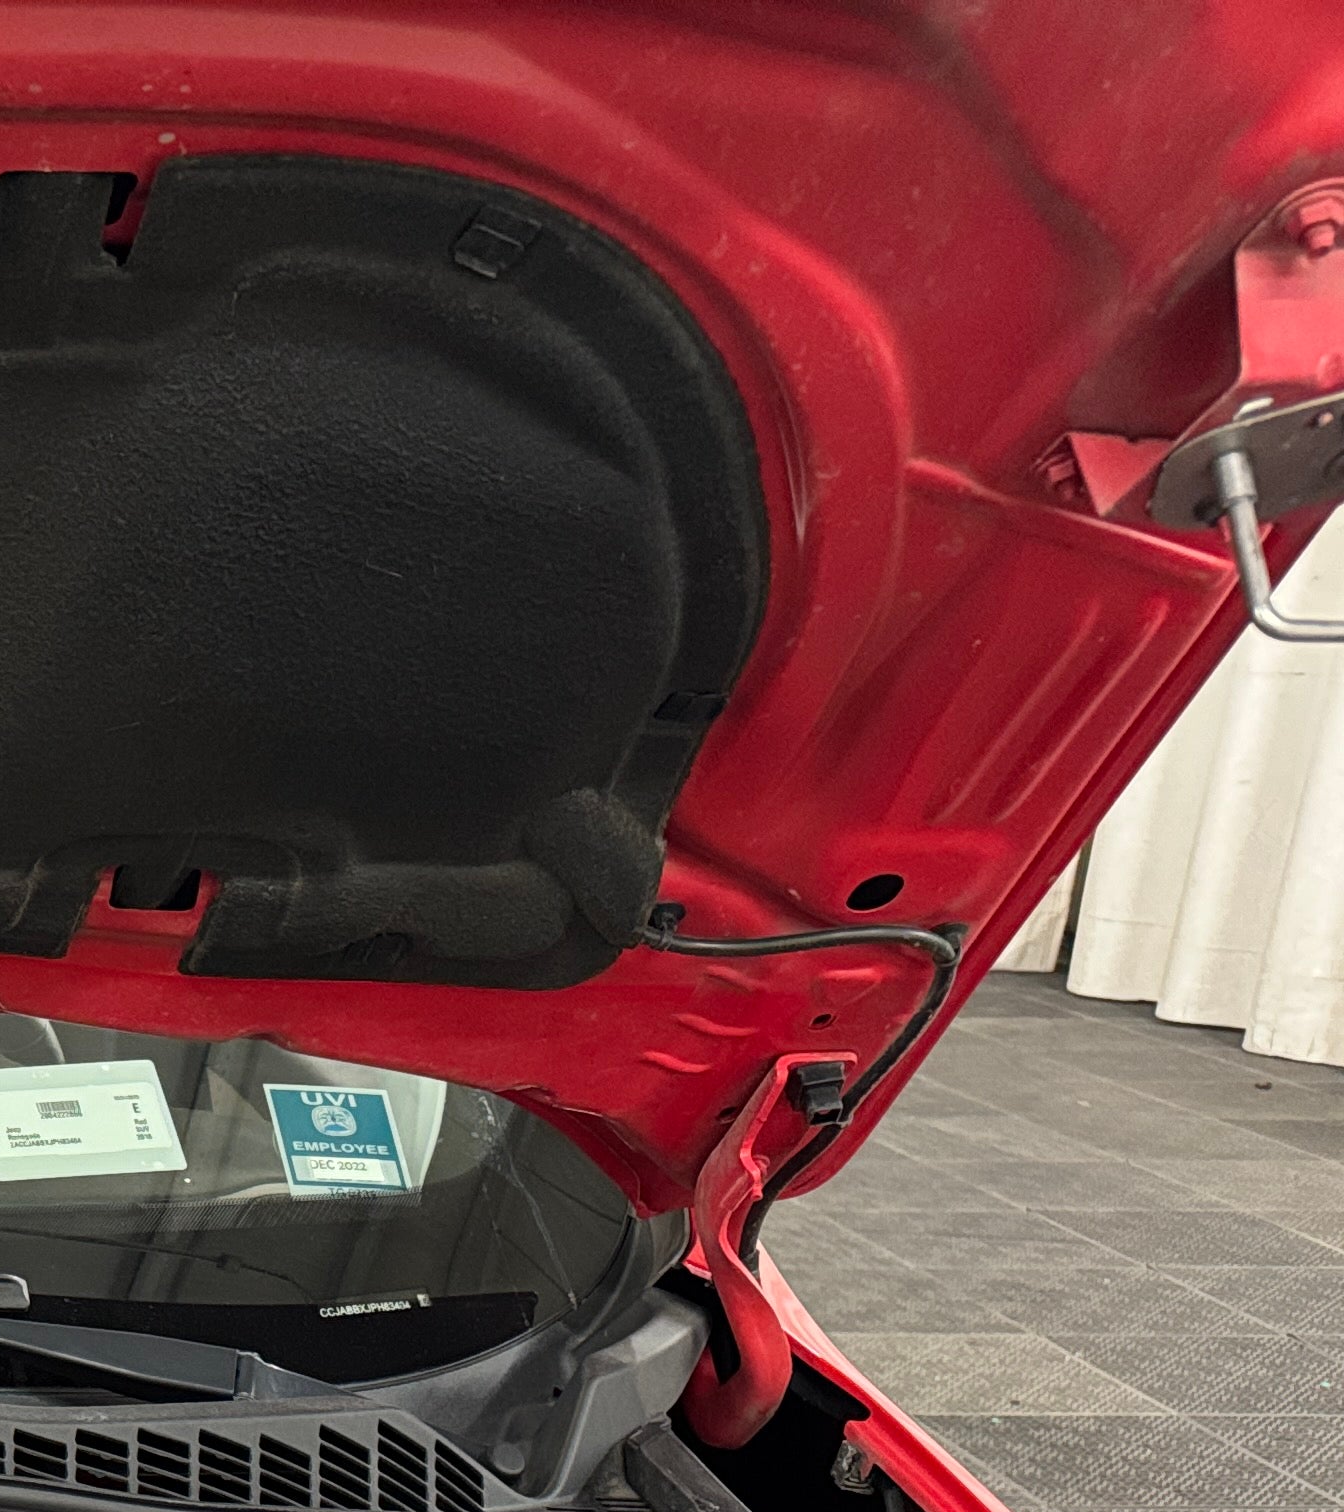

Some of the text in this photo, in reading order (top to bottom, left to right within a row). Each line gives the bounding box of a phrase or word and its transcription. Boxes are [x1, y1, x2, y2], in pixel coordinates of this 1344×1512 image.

[300, 1091, 358, 1108] UVI
[131, 1102, 141, 1114] E
[292, 1141, 390, 1155] EMPLOYEE
[310, 1160, 368, 1171] DEC 2022
